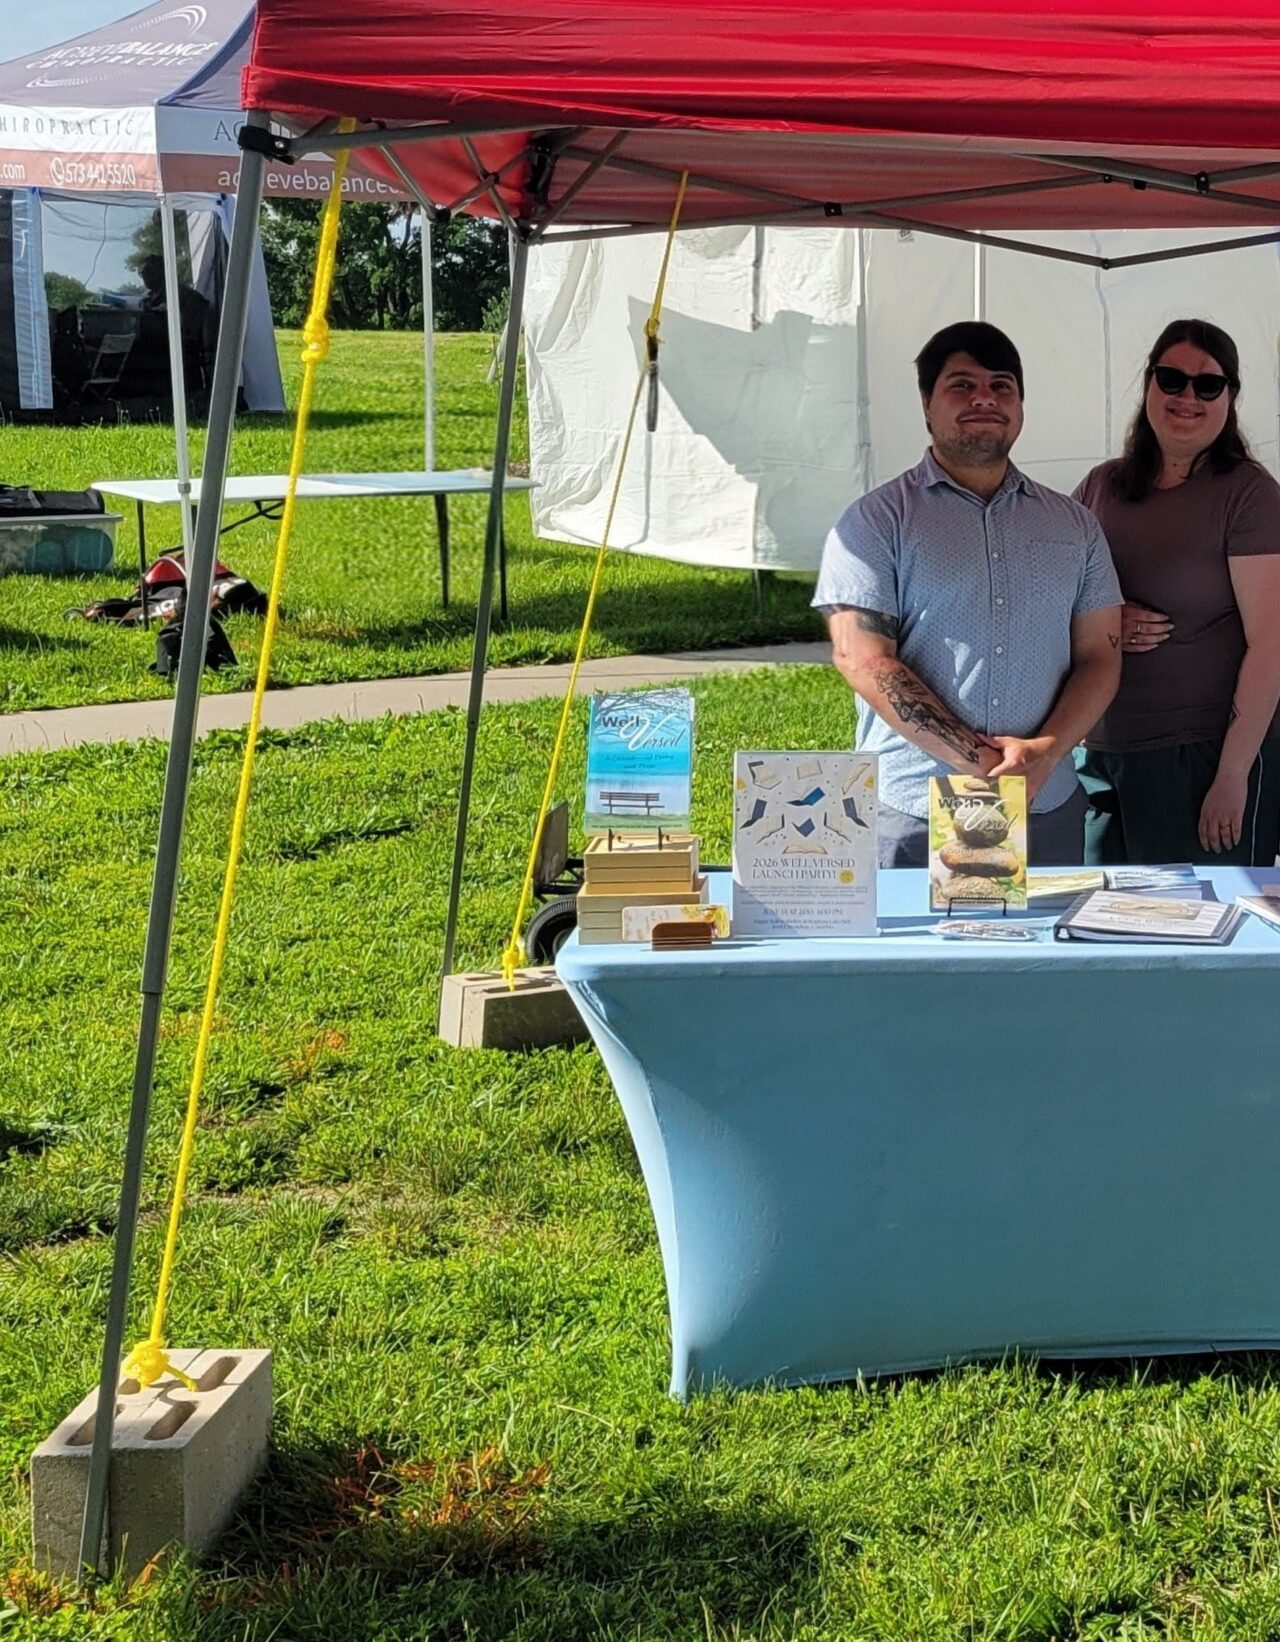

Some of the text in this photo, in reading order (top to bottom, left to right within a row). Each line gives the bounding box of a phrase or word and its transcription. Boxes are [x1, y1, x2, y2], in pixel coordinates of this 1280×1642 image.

[0, 116, 135, 136] HIROPRACTIC
[752, 858, 778, 868] 2026
[813, 858, 855, 868] VERSED
[752, 869, 799, 879] LAUNCH
